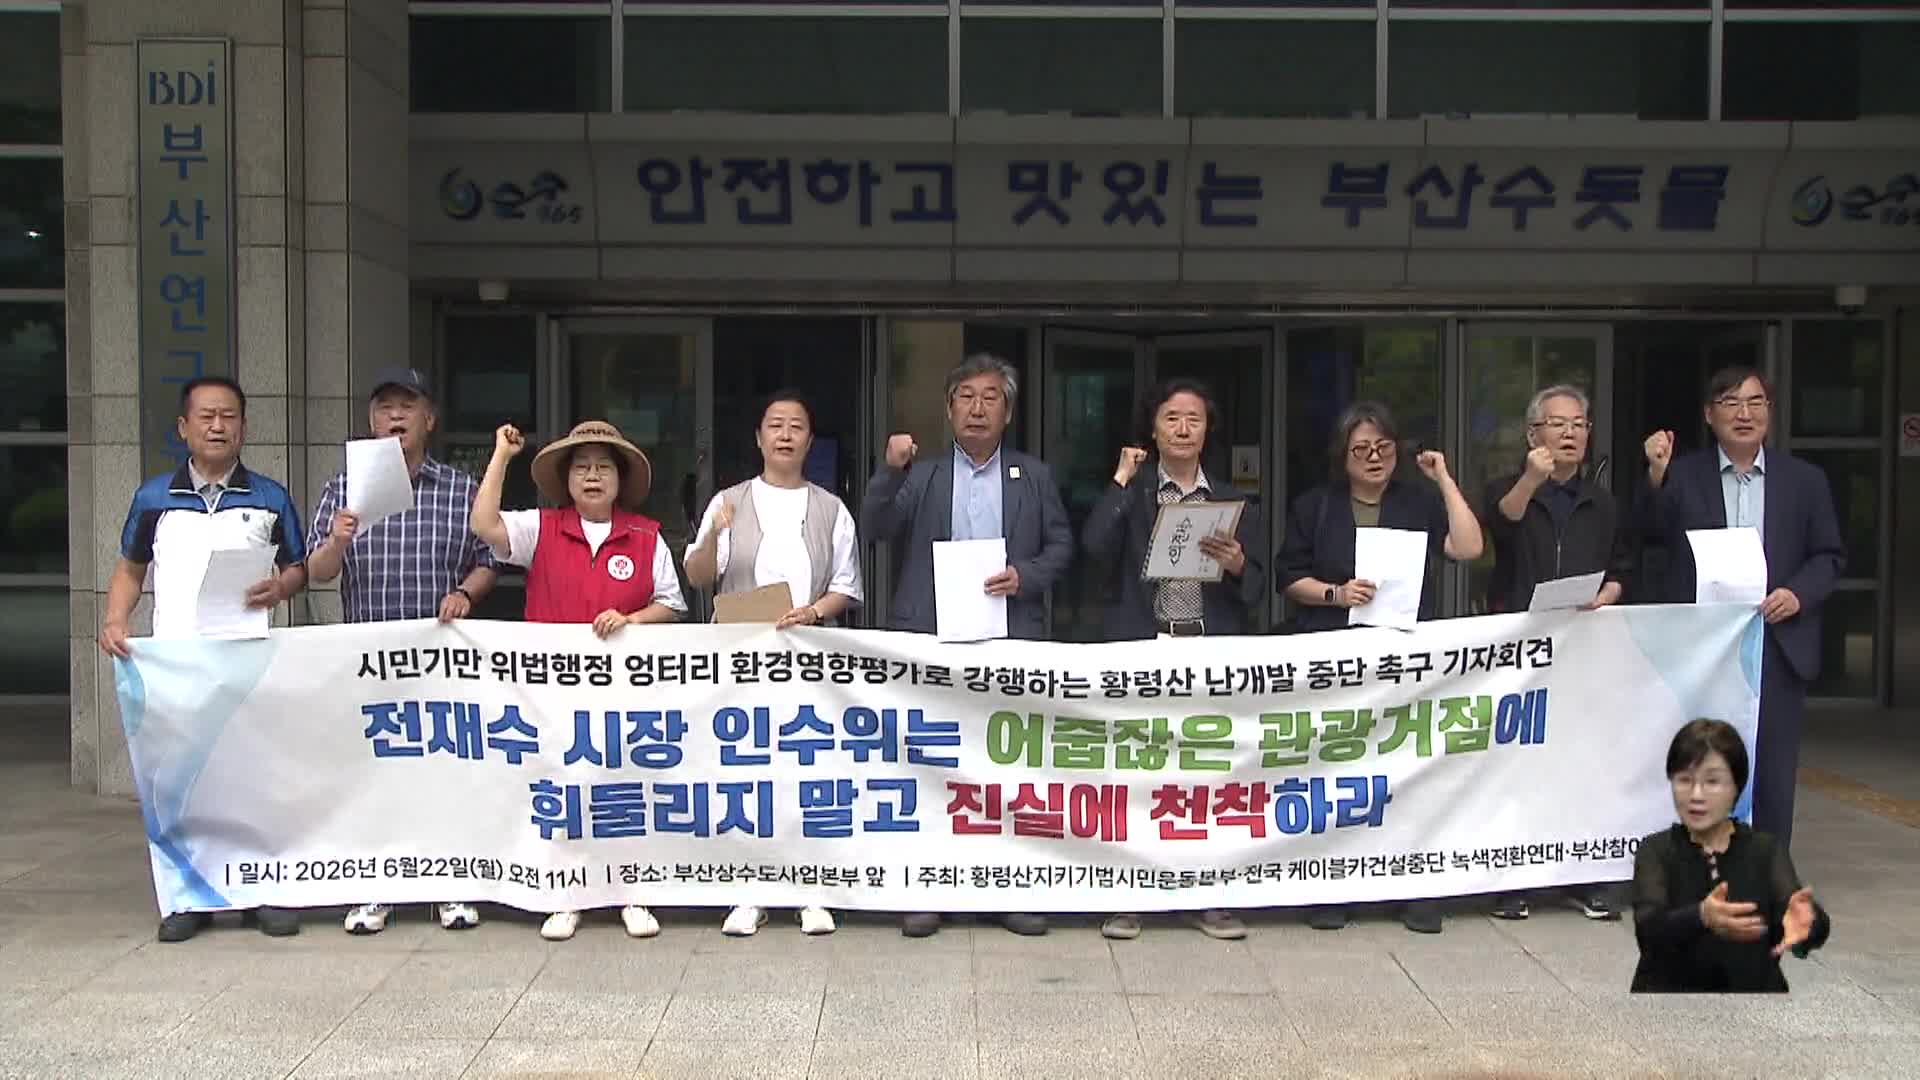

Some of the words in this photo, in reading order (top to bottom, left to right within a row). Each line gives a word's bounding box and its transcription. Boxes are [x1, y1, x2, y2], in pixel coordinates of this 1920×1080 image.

[636, 156, 958, 226] 안전하고
[1006, 158, 1265, 228] 맛있는
[1320, 160, 1732, 232] 부산수돗물
[358, 648, 482, 680] 시민기만
[491, 651, 612, 686] 위법행정
[625, 653, 718, 686] 엉터리
[731, 651, 953, 688] 환경영향평가로
[964, 667, 1090, 698] 강행하는
[1101, 668, 1195, 698] 황령산
[1206, 663, 1296, 696] 난개발
[1307, 658, 1367, 690] 중단
[1376, 653, 1433, 684] 촉구
[1443, 637, 1552, 675] 기자회견
[362, 701, 539, 765] 전재수
[564, 710, 688, 769] 시장
[713, 705, 960, 768] 인수위는
[987, 711, 1234, 771] 어줍잖은
[1258, 689, 1547, 764] 관광거점에
[529, 780, 773, 840] 휘둘리지
[799, 779, 919, 838] 말고
[946, 782, 1128, 841] 진실에
[1151, 776, 1393, 840] 천착하라
[240, 862, 287, 884] 일시:
[296, 857, 376, 880] 2026년
[384, 857, 503, 880] 6월22일(월)
[509, 864, 539, 889] 오전
[546, 867, 586, 889] 11시
[620, 864, 666, 883] 장소:
[674, 864, 859, 887] 부산상수도사업본부
[866, 867, 885, 887] 앞
[919, 866, 964, 887] 주최:
[1288, 852, 1445, 880] 케이블카건설중단
